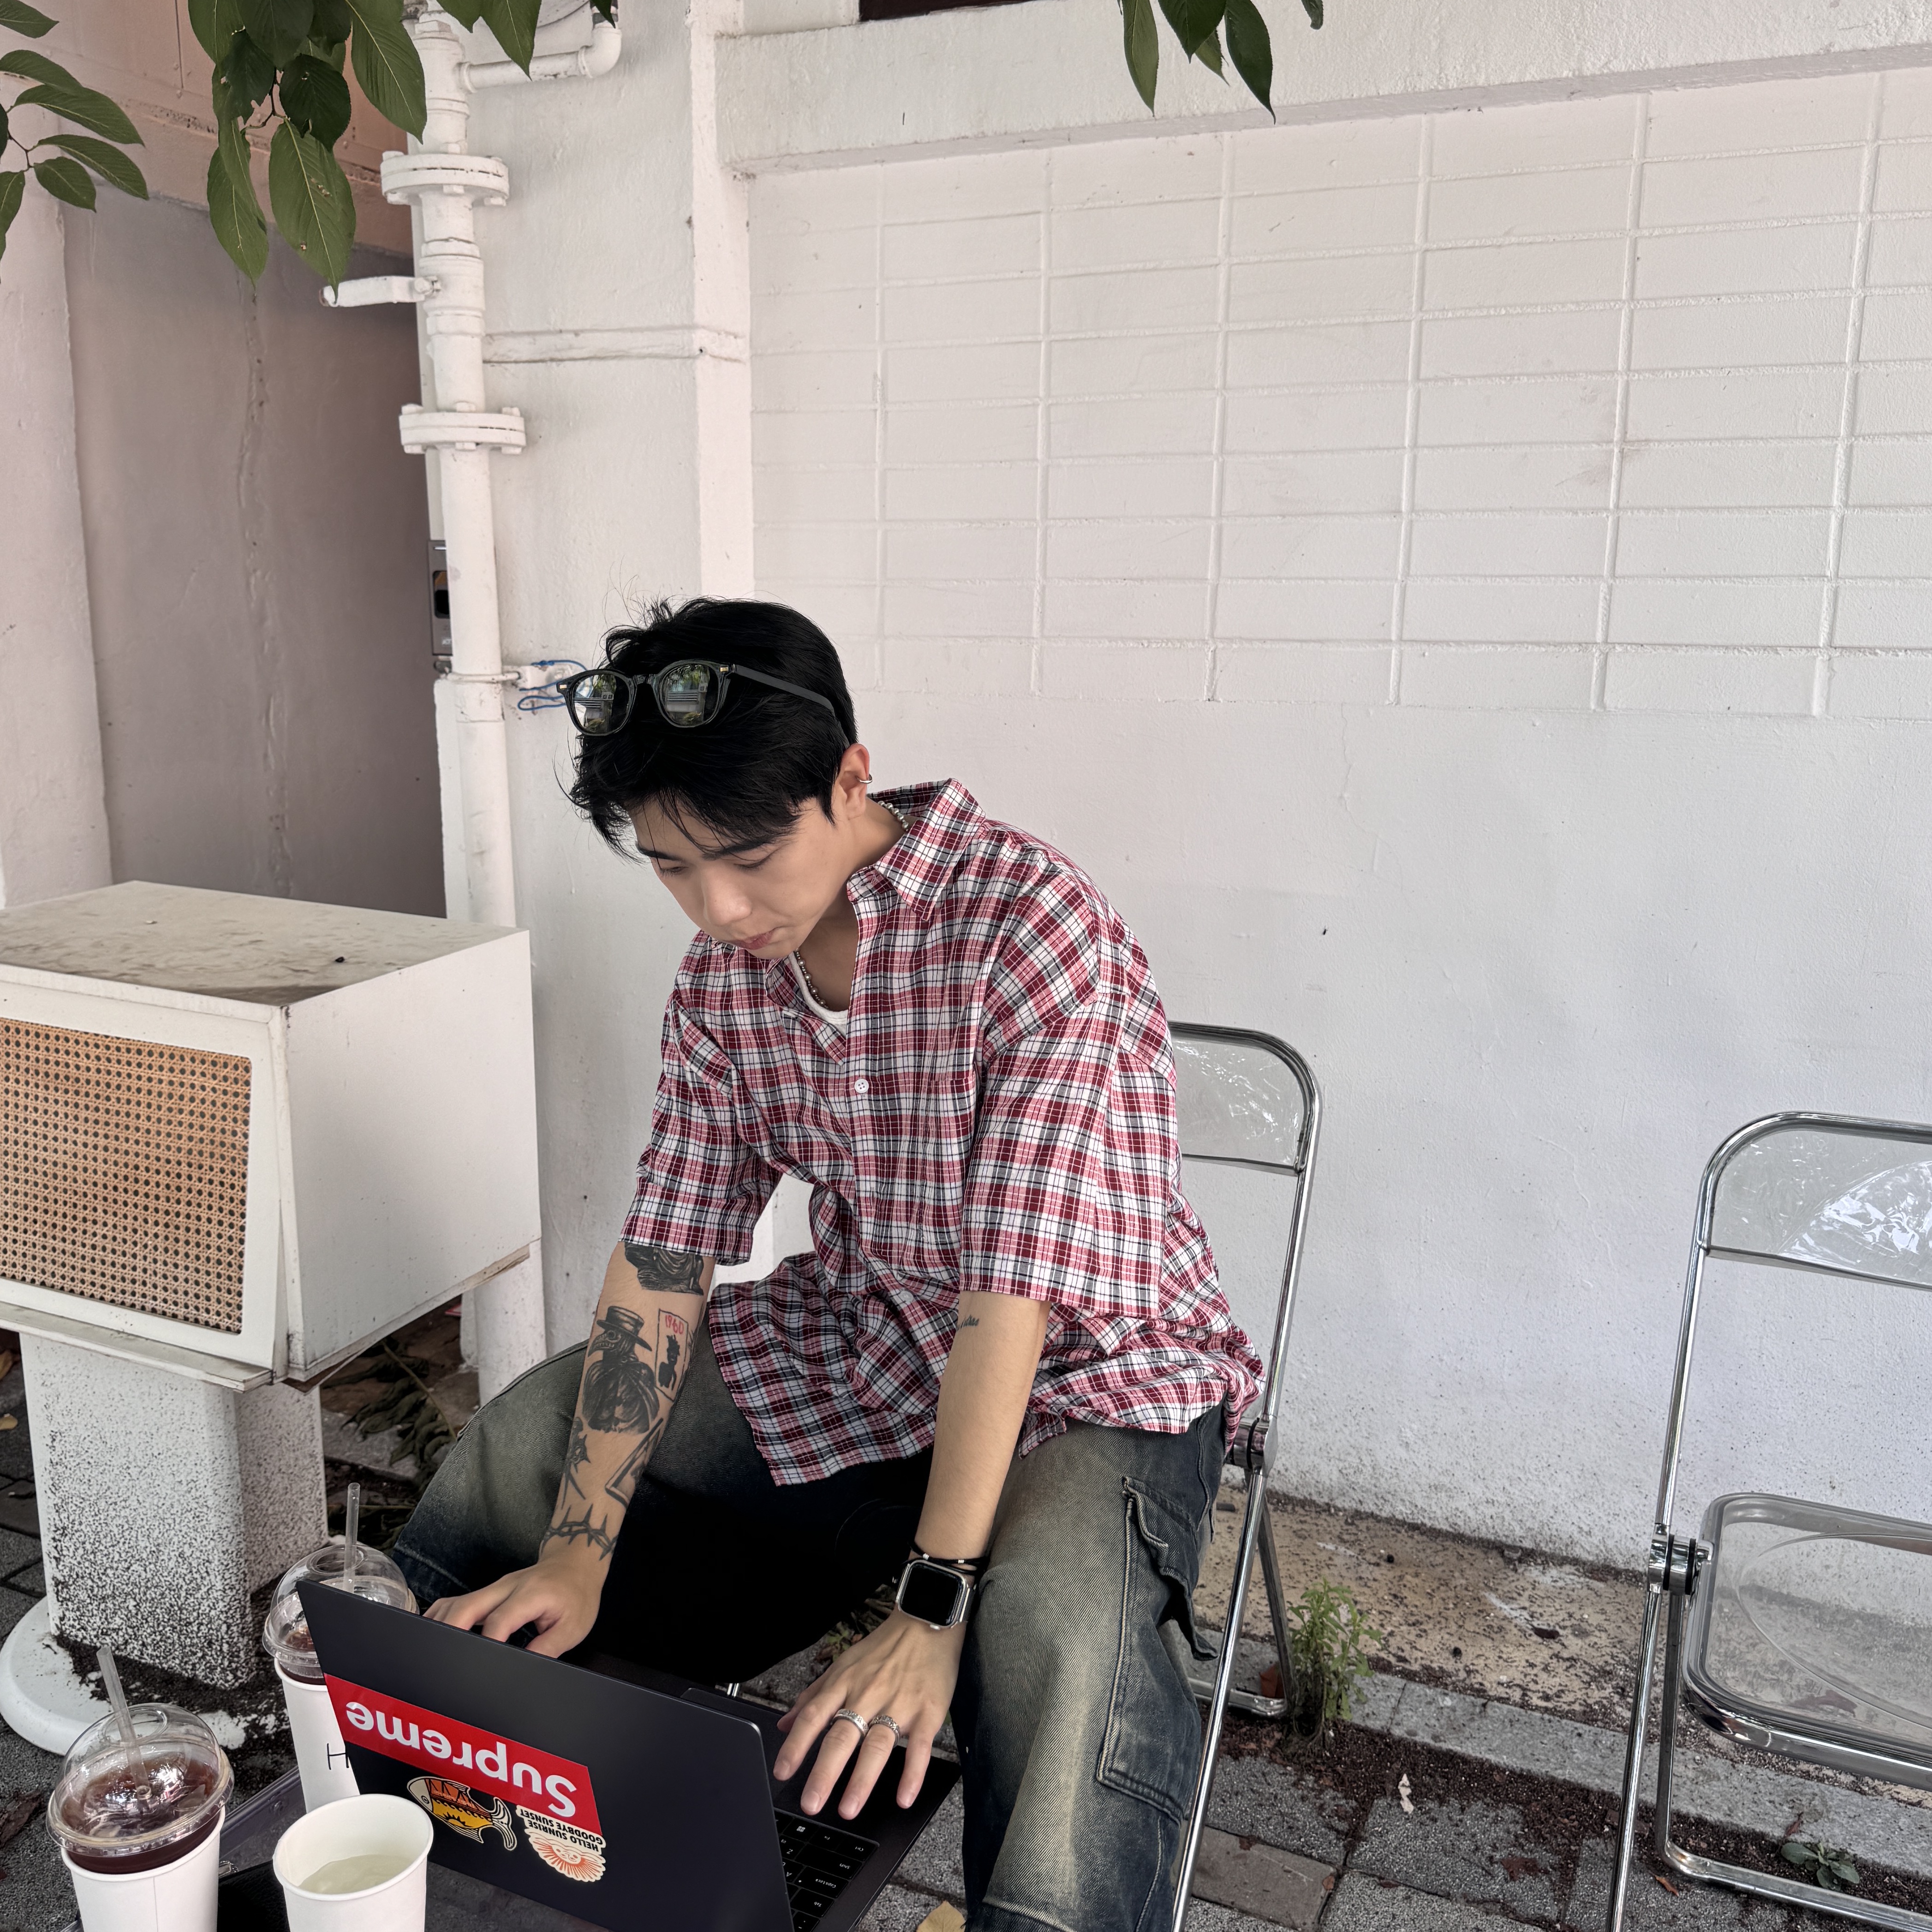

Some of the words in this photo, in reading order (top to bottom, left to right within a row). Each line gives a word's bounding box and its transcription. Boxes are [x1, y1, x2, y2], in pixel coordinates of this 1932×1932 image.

[665, 1315, 684, 1334] 1960
[346, 1702, 576, 1817] Supreme
[520, 1808, 554, 1827] SUNSET
[528, 1820, 567, 1840] SUNRISE
[556, 1822, 603, 1845] GOODBYE
[570, 1836, 599, 1852] HELLO
